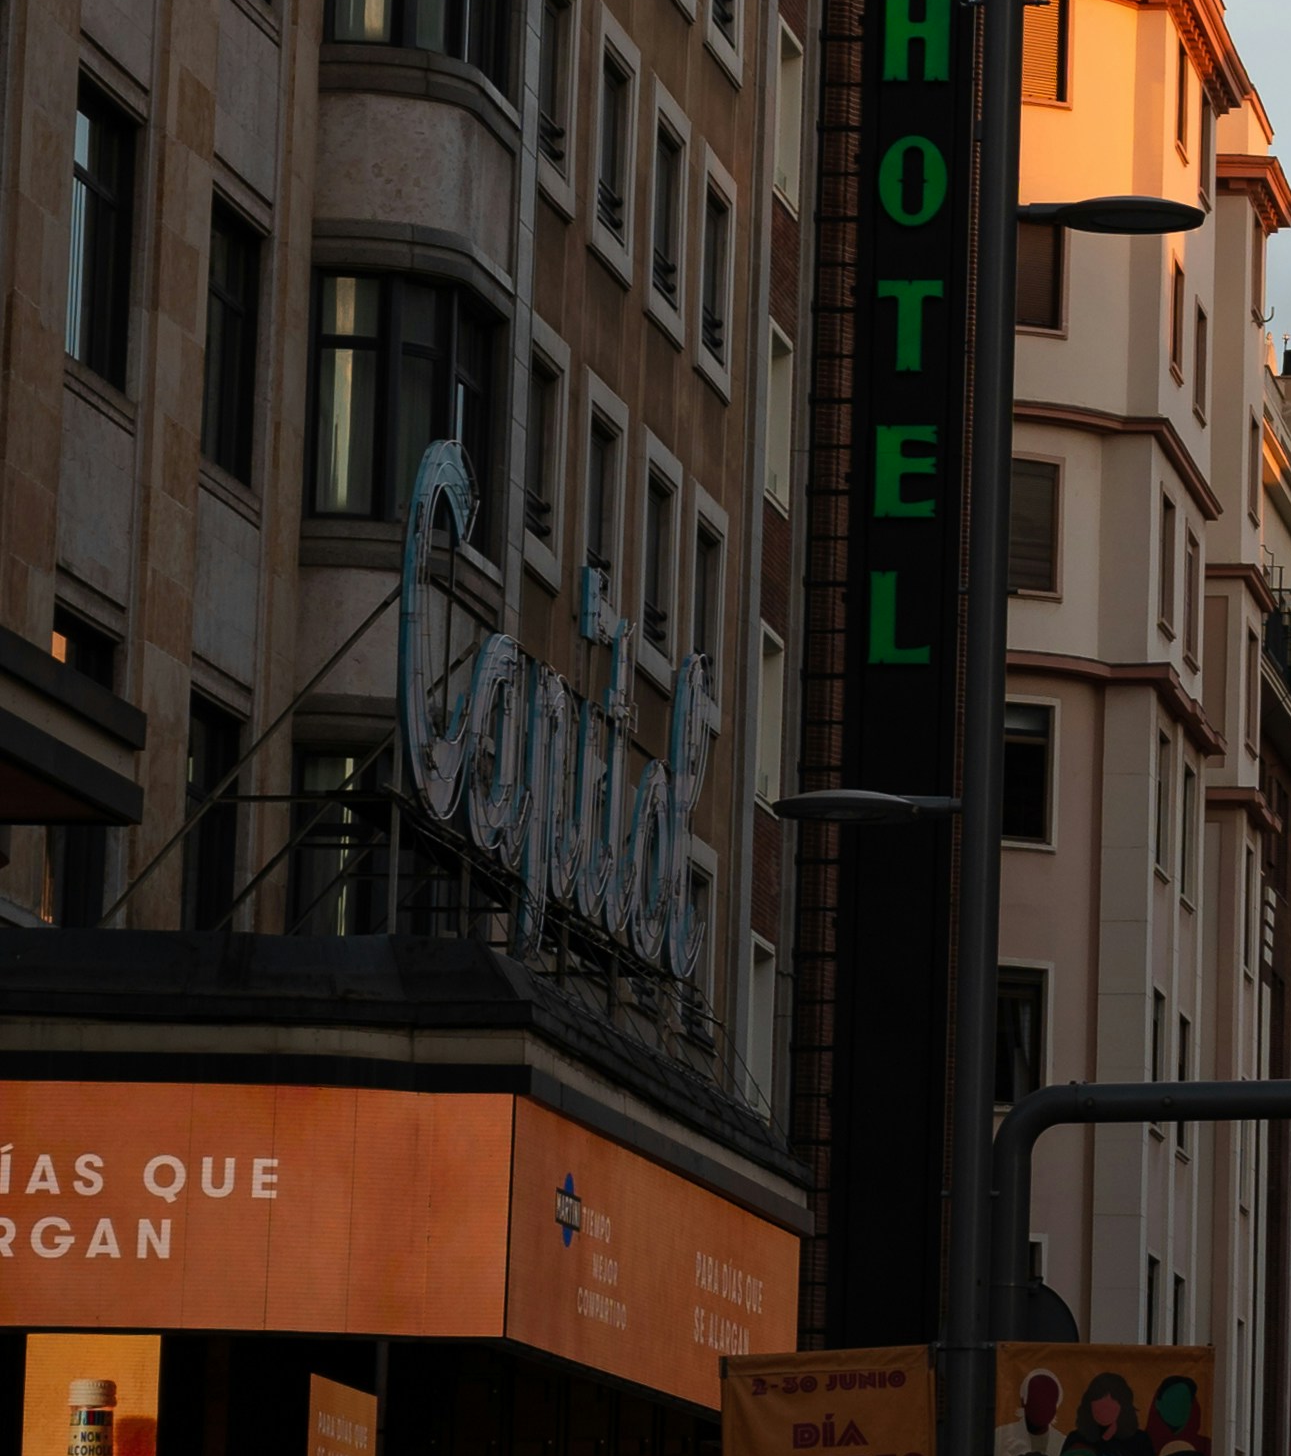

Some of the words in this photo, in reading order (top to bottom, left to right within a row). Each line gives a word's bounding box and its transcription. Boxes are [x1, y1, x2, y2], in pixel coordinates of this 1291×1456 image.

[143, 1154, 279, 1204] QUE
[582, 1206, 612, 1244] TIEMPO
[592, 1252, 619, 1287] MEJOR
[695, 1250, 720, 1295] PARA
[722, 1258, 743, 1307] DÍAS
[745, 1274, 764, 1315] QUE
[577, 1286, 627, 1331] COMPARTIDO
[694, 1305, 705, 1345] SE
[708, 1312, 750, 1355] ALARGAN
[751, 1376, 818, 1396] 2-30
[826, 1370, 906, 1391] JUNIO
[80, 1431, 101, 1442] NON
[793, 1413, 869, 1449] DÍA
